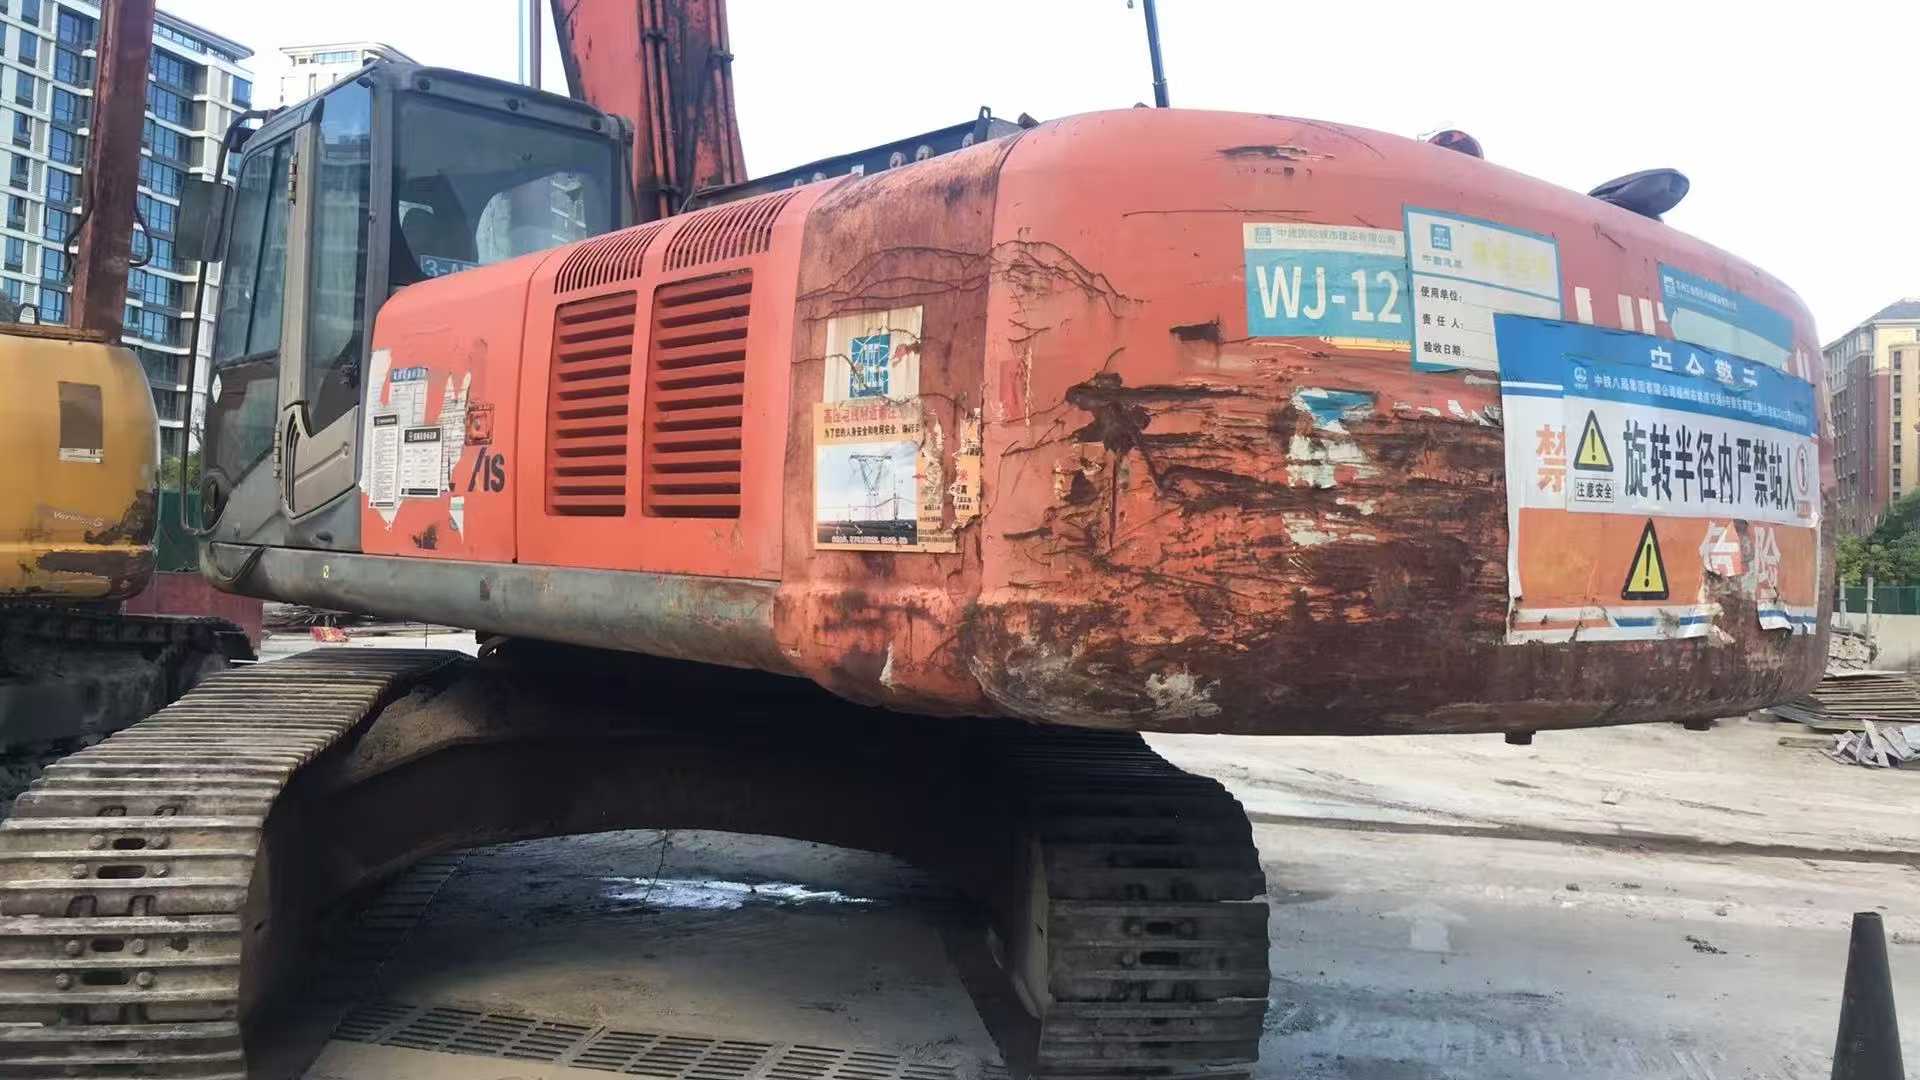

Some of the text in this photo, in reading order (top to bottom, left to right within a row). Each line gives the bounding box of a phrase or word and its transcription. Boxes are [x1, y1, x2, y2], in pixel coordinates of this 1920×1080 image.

[1256, 266, 1402, 324] WJ-12
[1576, 481, 1614, 499] 注意安全
[1623, 419, 1797, 512] 旋转半径内严禁站人
